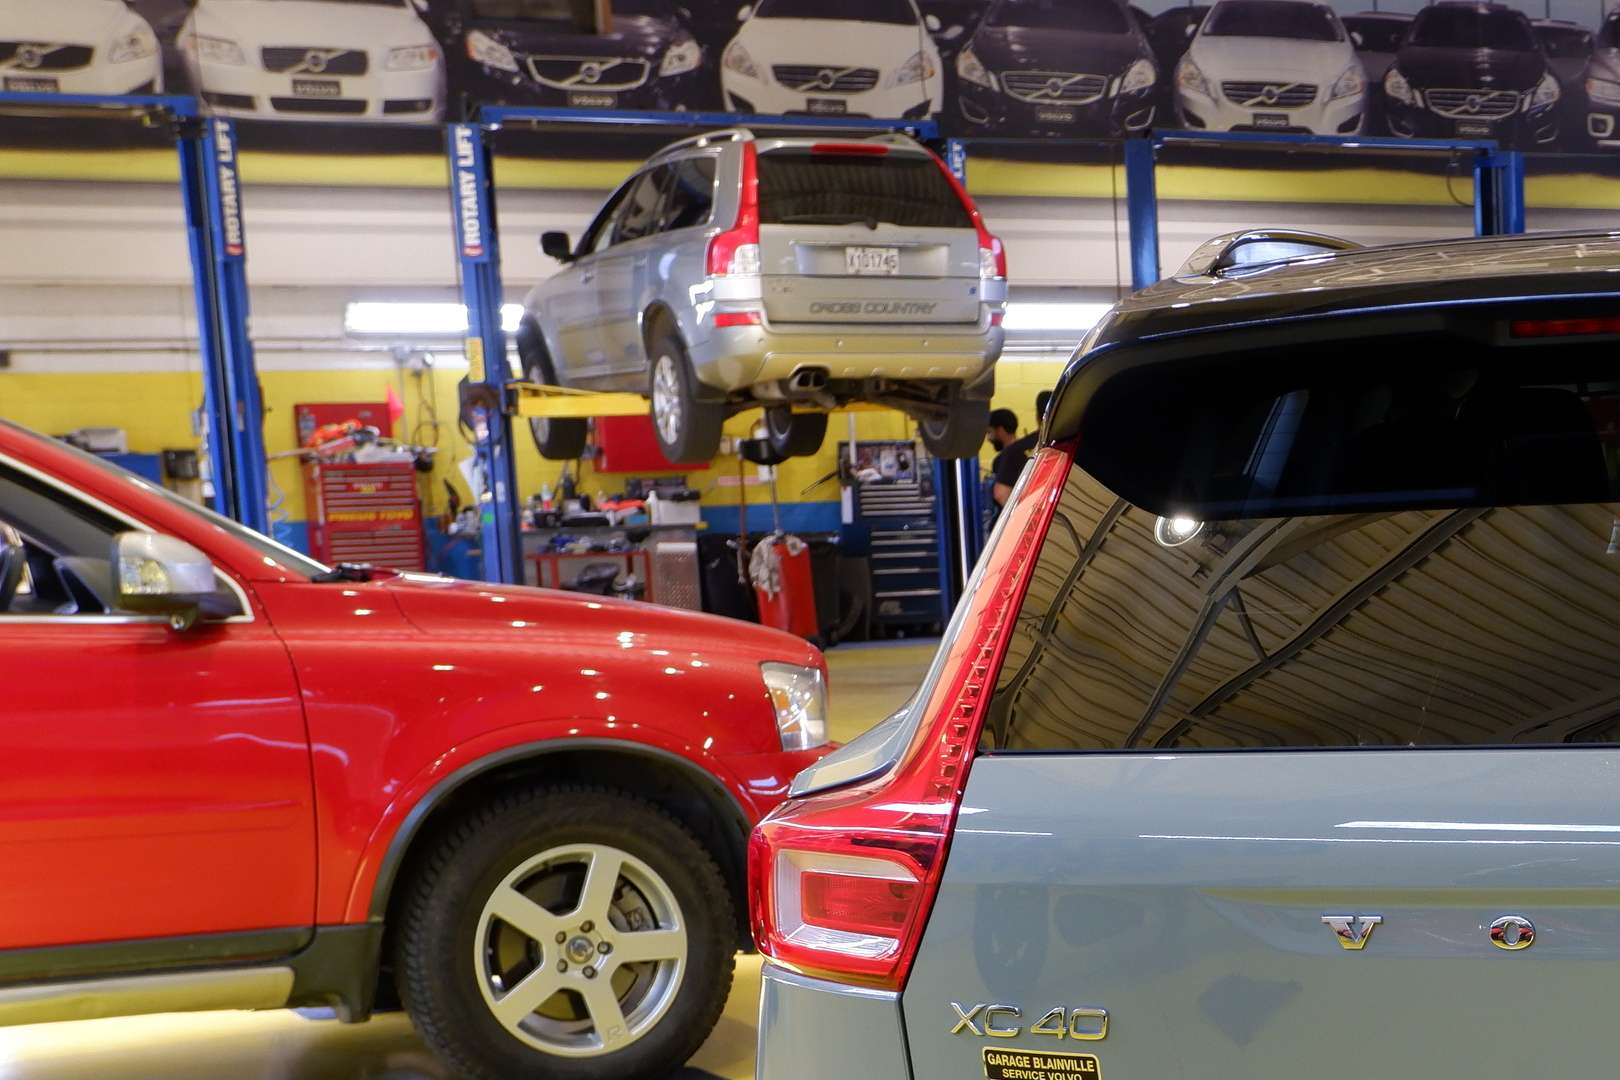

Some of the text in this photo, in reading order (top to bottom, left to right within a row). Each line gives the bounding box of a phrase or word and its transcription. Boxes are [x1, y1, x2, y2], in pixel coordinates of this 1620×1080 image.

[214, 120, 241, 245] ROTARY LIFT
[455, 124, 481, 246] ROTARY LIFT
[987, 1053, 1095, 1072] GARAGE BLAINVILLE
[1002, 1068, 1046, 1080] SERVICE
